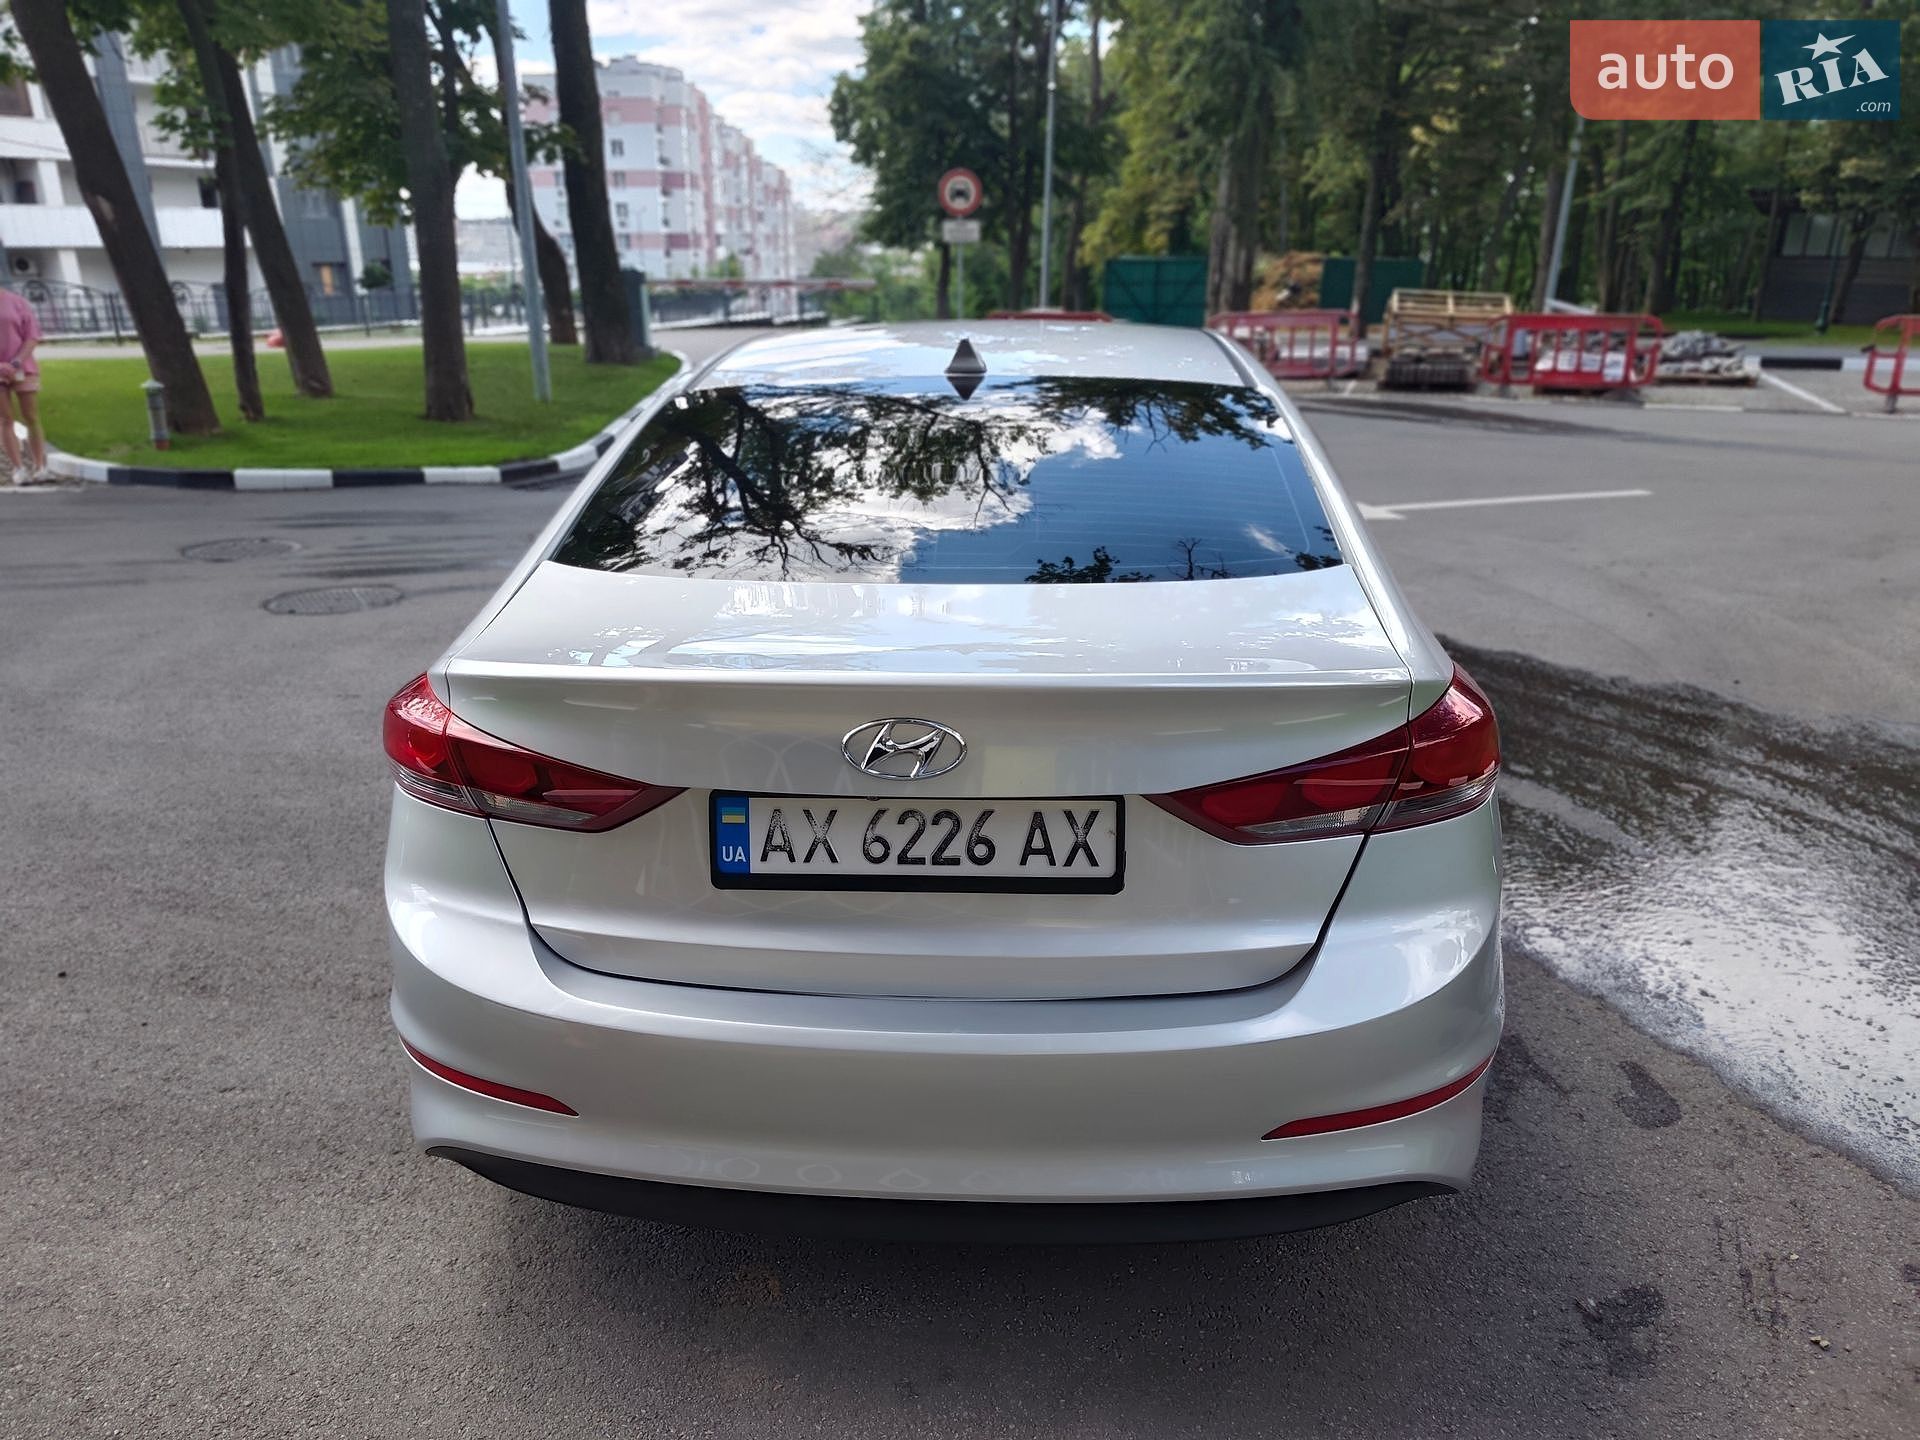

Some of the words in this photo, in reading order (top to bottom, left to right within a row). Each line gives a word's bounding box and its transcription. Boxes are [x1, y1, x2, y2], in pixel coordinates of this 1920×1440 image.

[722, 846, 747, 863] UA
[760, 808, 839, 863] AX
[863, 808, 996, 866] 6226
[1020, 810, 1100, 868] AX
